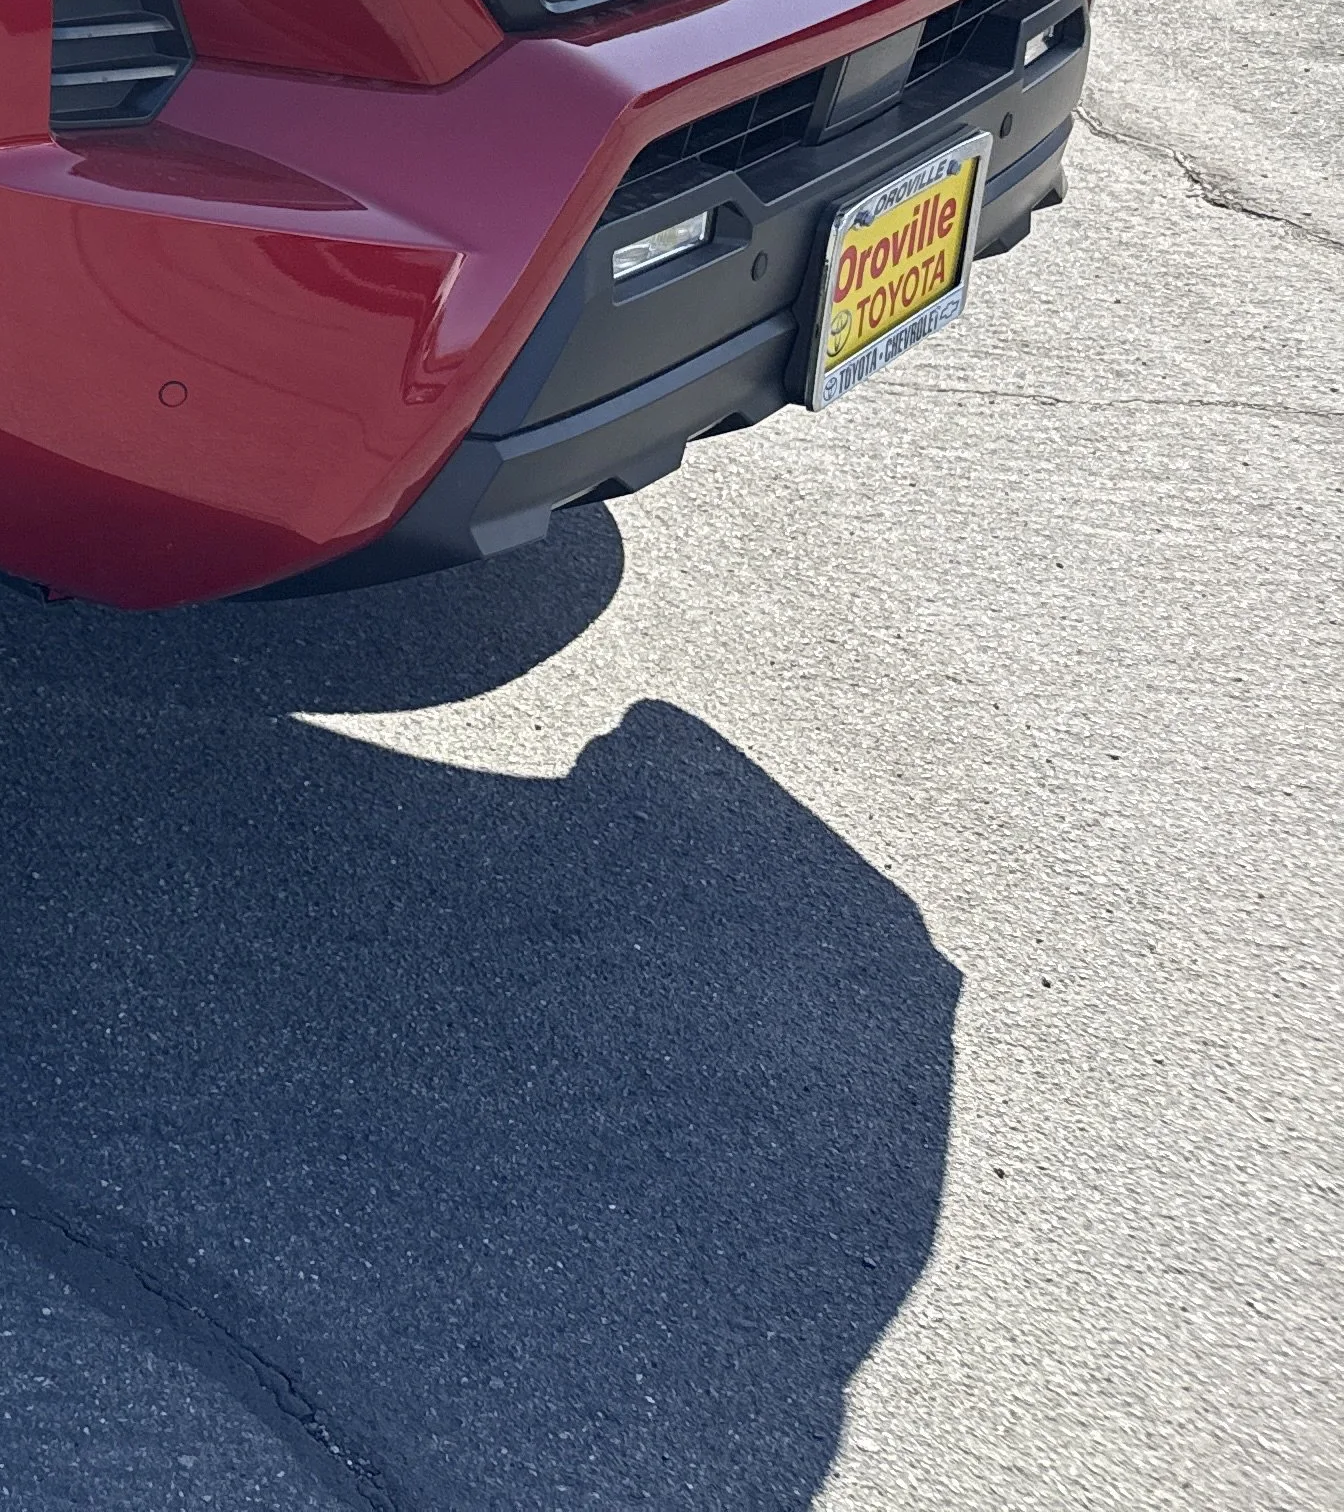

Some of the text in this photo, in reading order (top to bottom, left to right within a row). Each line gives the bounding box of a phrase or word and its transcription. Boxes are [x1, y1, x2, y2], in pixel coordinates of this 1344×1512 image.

[874, 157, 948, 218] OROVILLE
[832, 192, 957, 305] Oroville
[856, 248, 946, 339] TOYOTA
[838, 305, 941, 395] TOYOTA CHEVROLET
